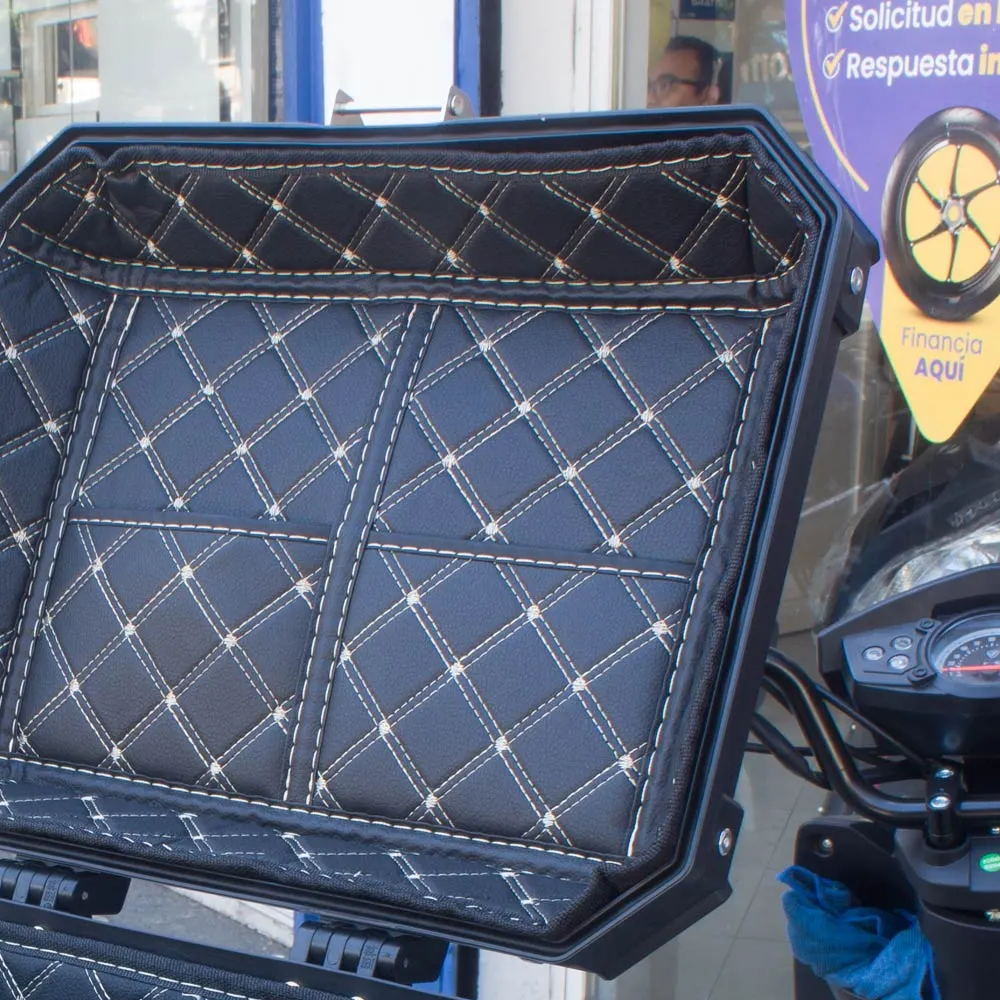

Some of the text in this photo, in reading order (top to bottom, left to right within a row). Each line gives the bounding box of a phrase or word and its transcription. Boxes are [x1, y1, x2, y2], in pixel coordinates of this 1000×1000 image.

[849, 0, 953, 32] Solicitud
[957, 2, 992, 26] en
[846, 48, 974, 87] Respuesta
[901, 326, 983, 354] Financia
[914, 355, 965, 382] AQUÍ
